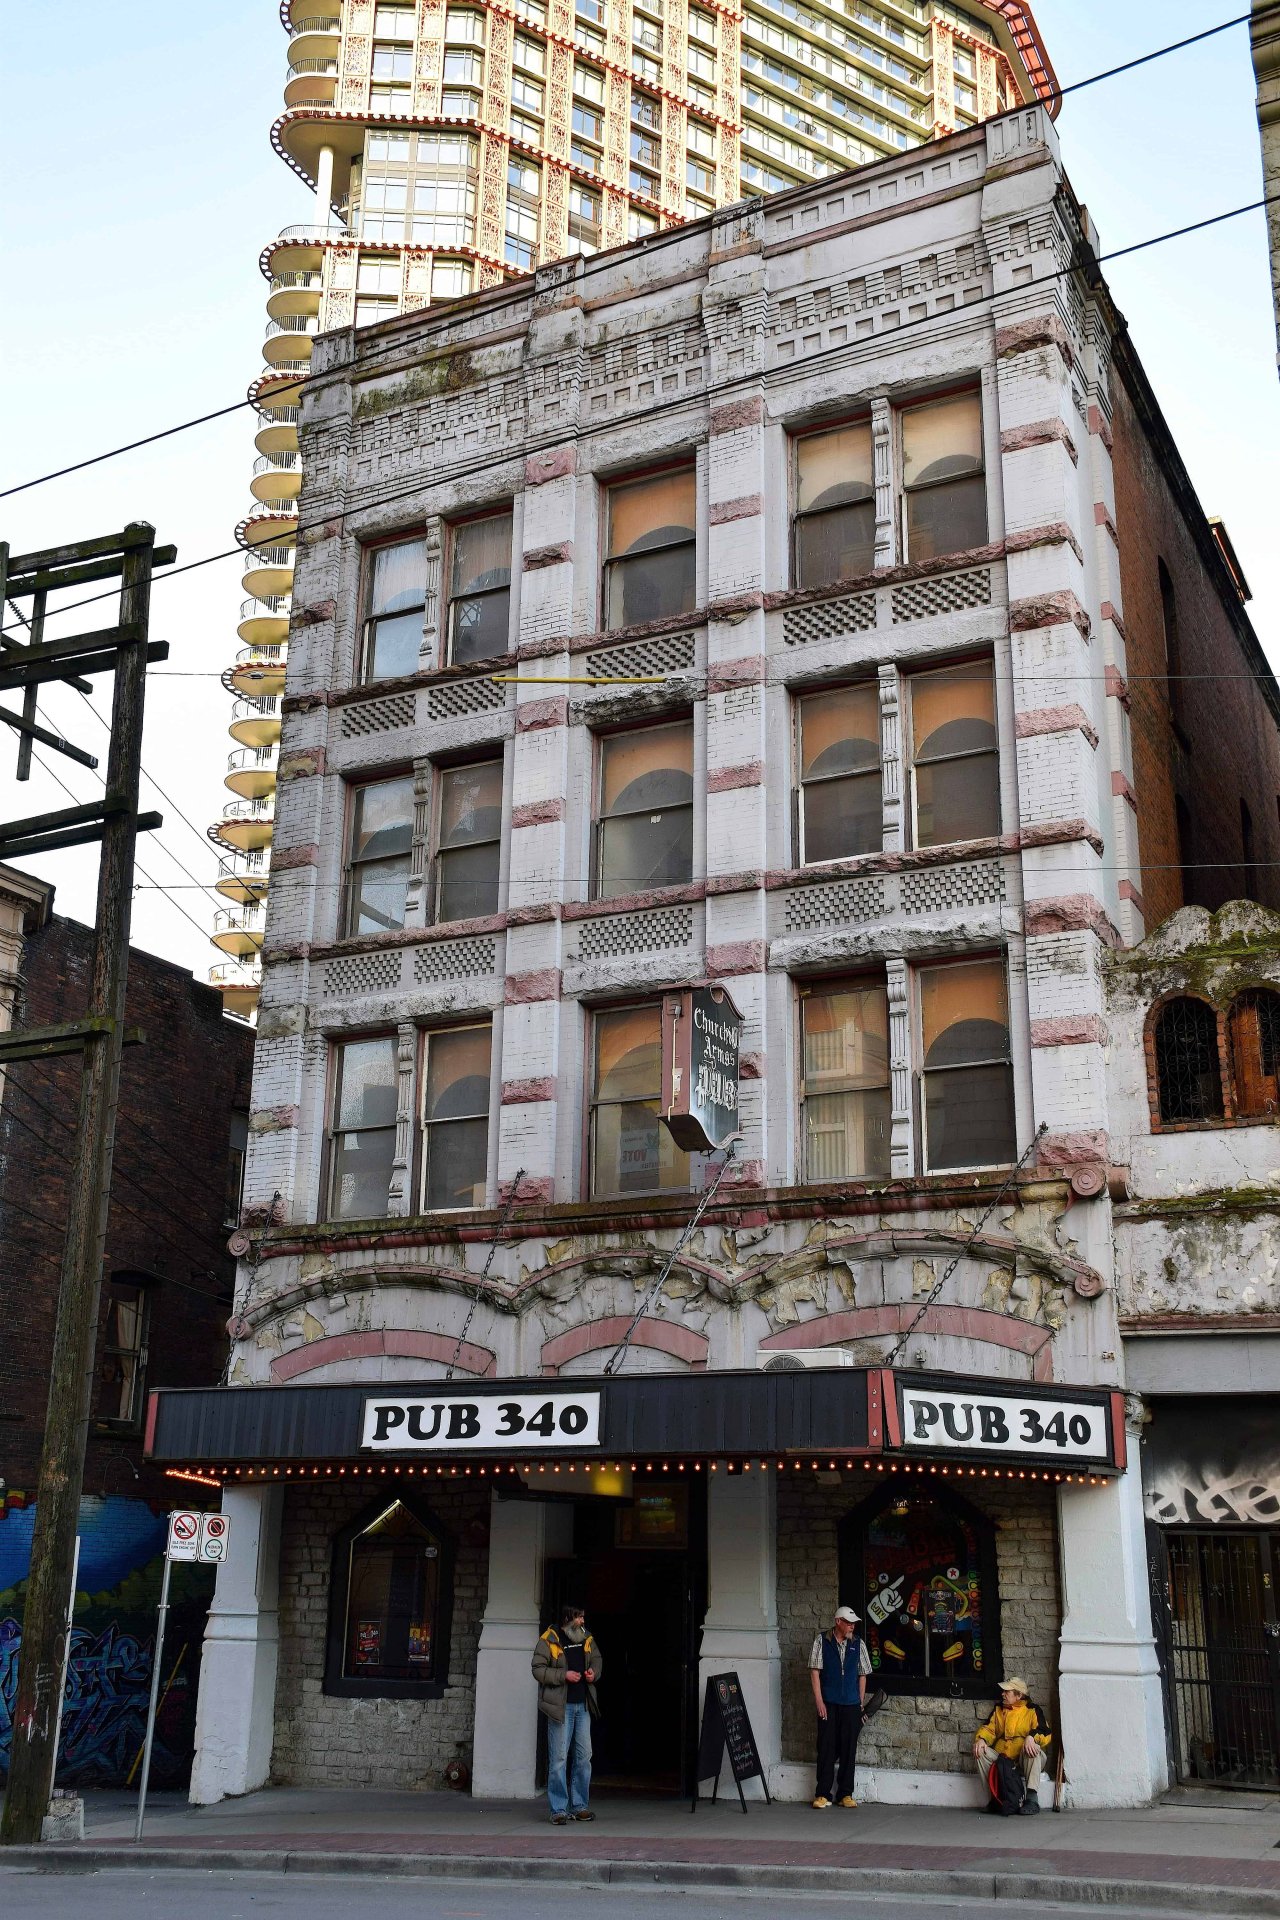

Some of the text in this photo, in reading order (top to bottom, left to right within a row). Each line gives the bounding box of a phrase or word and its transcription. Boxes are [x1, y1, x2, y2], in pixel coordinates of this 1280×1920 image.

[372, 1401, 589, 1440] PUB 340
[909, 1399, 1092, 1447] PUB 340
[870, 1601, 887, 1620] WIN
